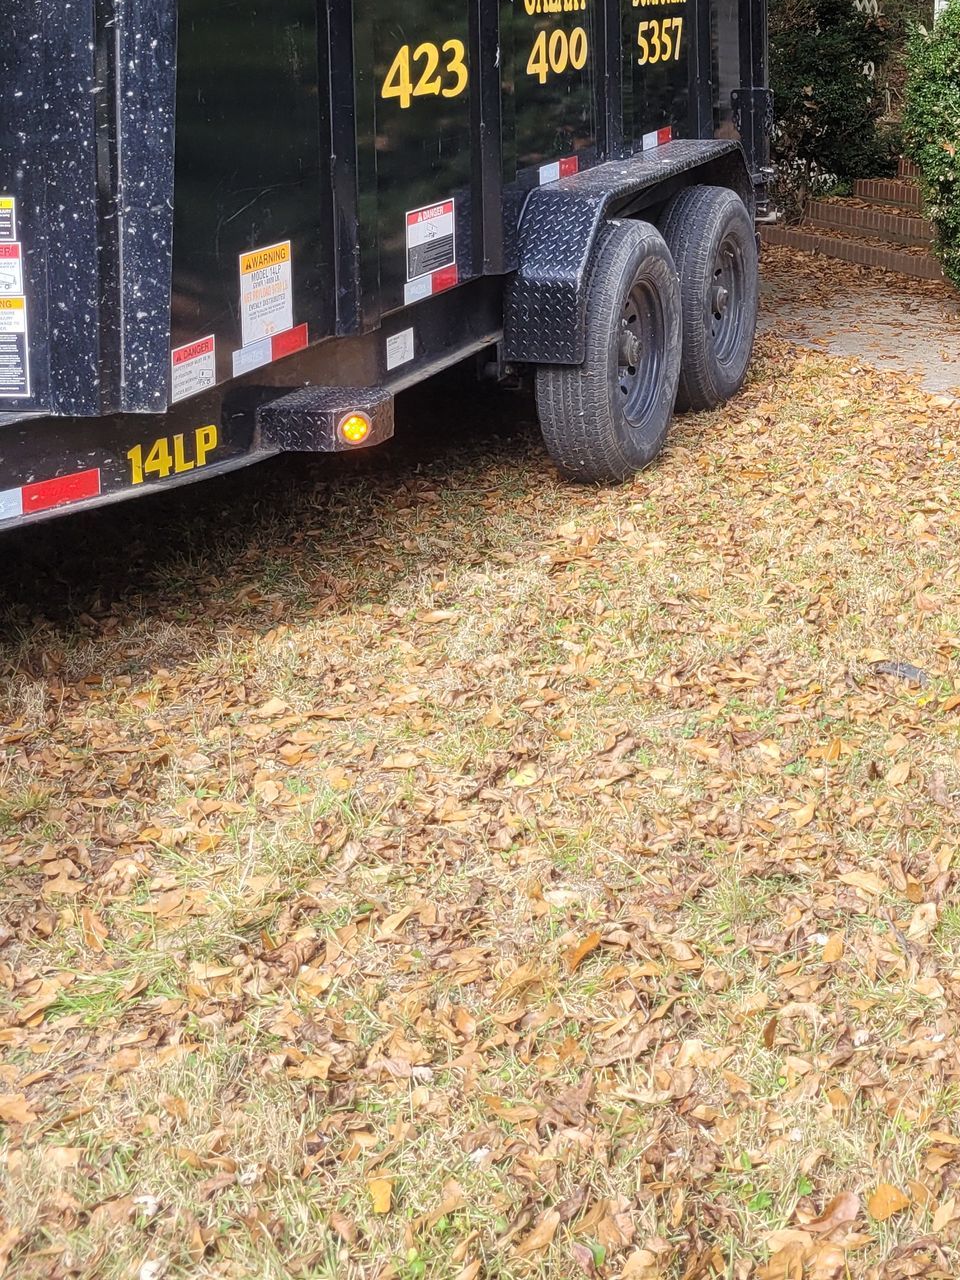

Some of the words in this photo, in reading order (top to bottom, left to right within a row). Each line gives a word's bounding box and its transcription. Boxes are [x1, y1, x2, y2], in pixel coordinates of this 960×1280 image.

[381, 39, 468, 108] 423
[526, 27, 588, 84] 400
[637, 17, 683, 66] 5357
[423, 206, 444, 220] DANGER
[251, 248, 286, 268] WARNING
[251, 267, 269, 281] MODEL
[183, 342, 209, 359] DANGER
[127, 424, 217, 485] 14LP
